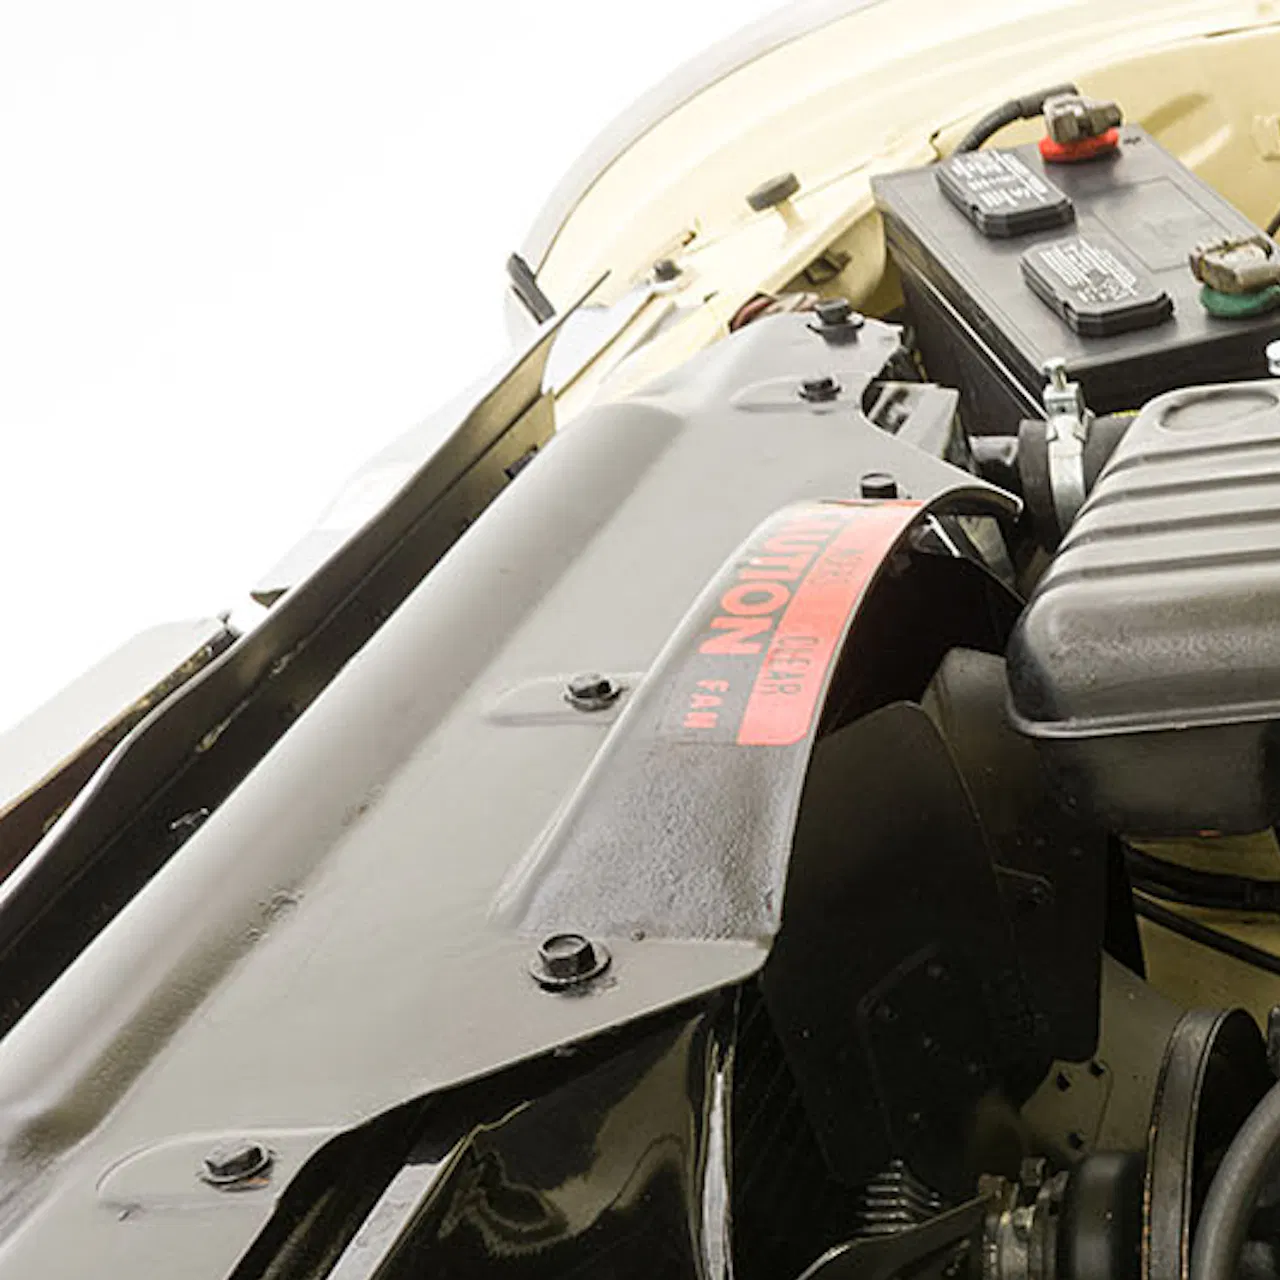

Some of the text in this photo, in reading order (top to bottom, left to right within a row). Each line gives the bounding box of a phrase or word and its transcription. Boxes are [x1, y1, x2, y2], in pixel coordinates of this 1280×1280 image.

[700, 515, 841, 655] AUTION
[760, 635, 819, 696] CLEAR
[683, 679, 730, 729] FAN
